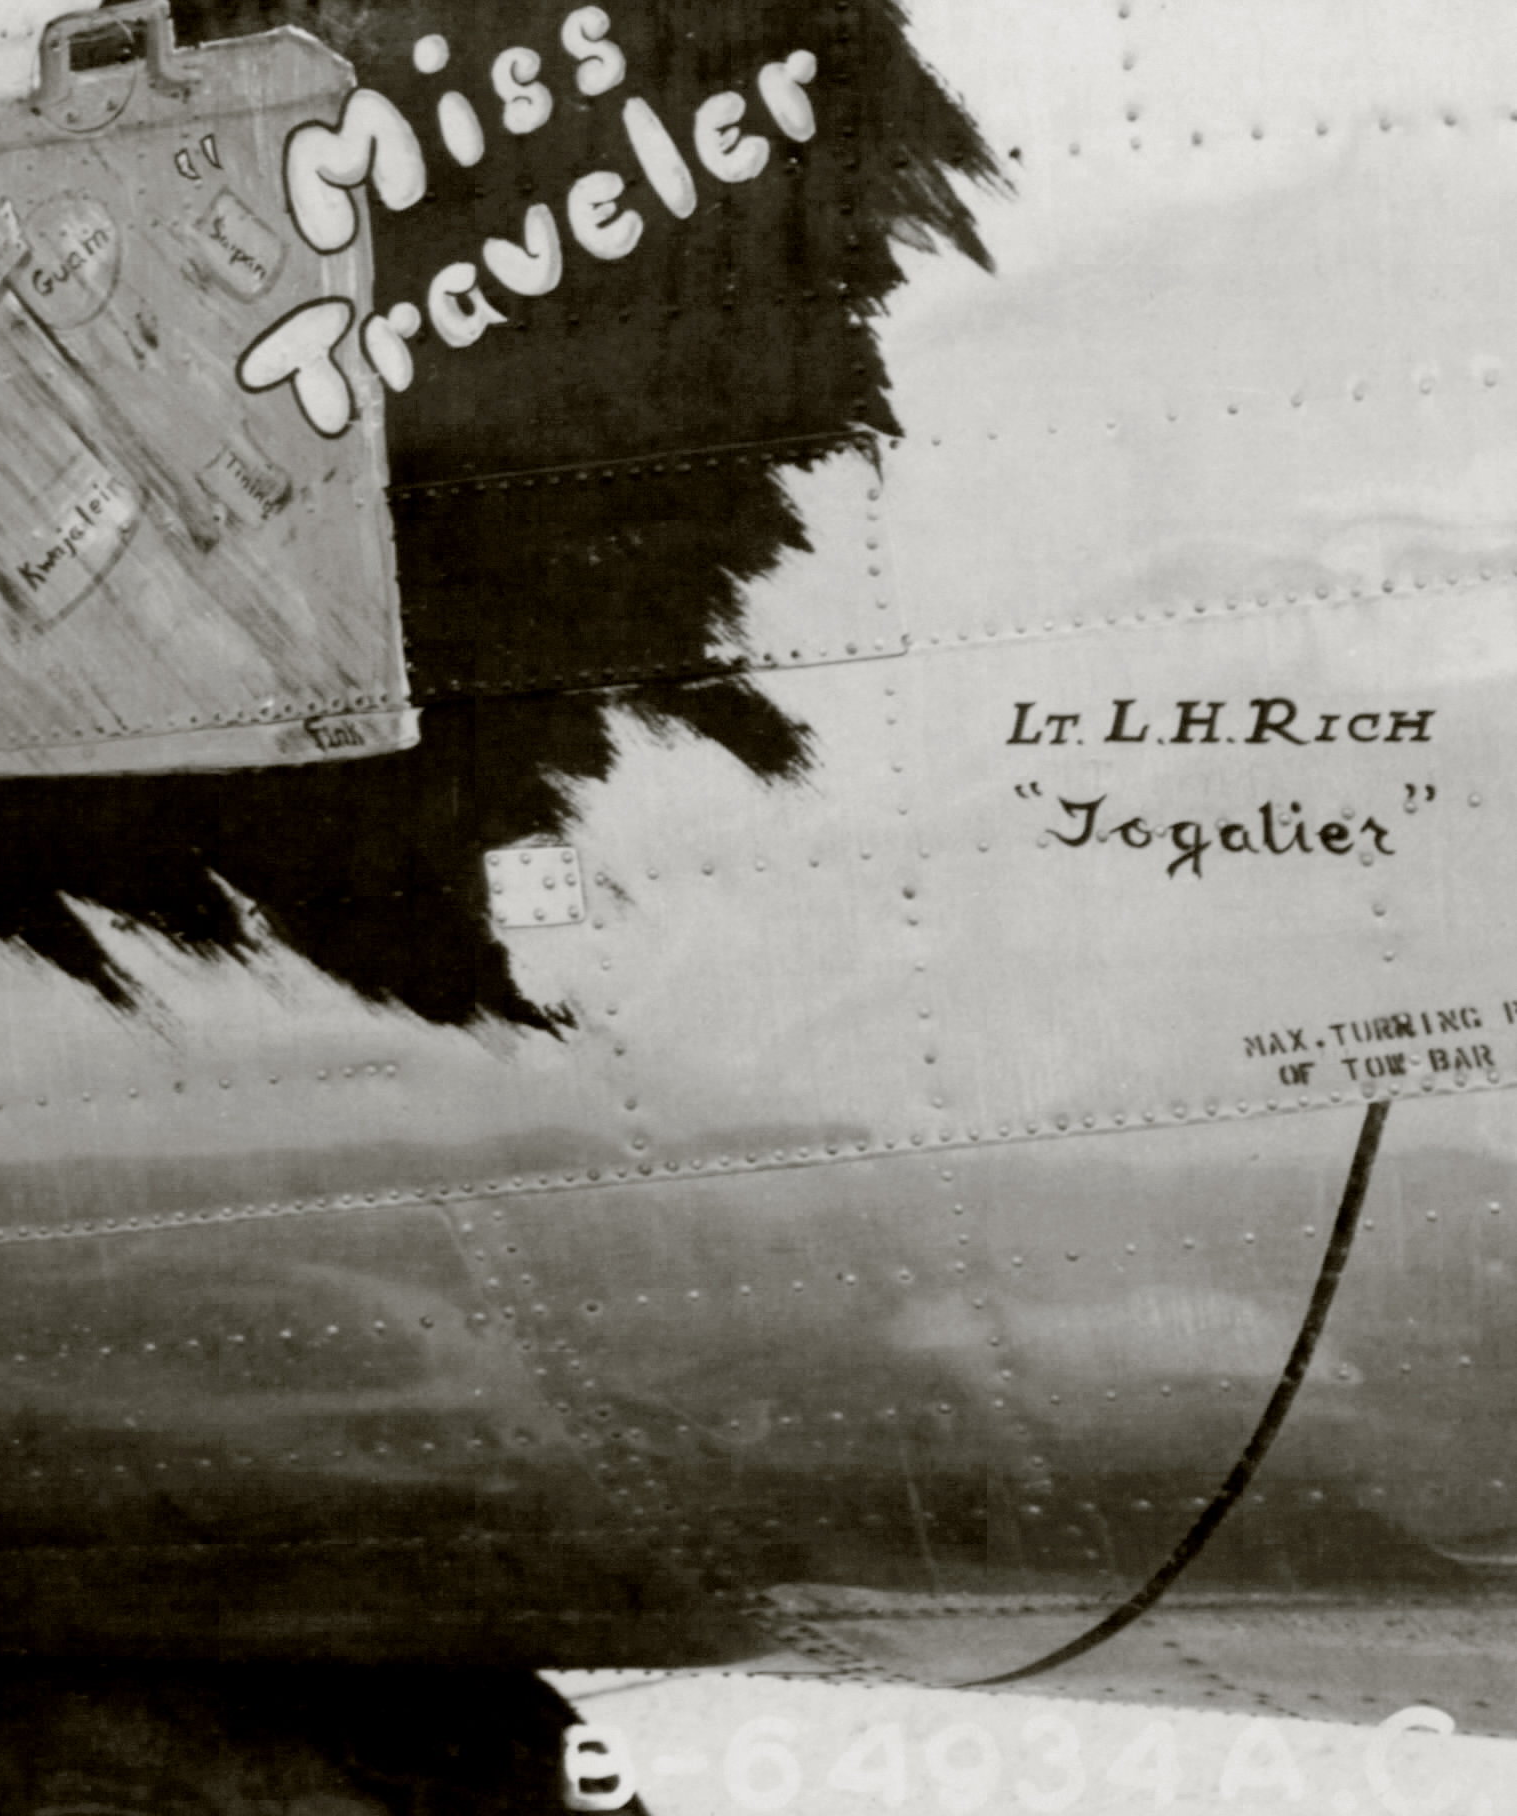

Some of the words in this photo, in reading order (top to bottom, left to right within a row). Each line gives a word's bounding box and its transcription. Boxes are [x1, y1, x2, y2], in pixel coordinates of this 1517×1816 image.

[32, 228, 110, 297] Guam
[236, 48, 818, 438] Traveler
[1278, 1060, 1315, 1086] OF
[1341, 1052, 1407, 1081] TOW
[1428, 1043, 1496, 1073] BAR
